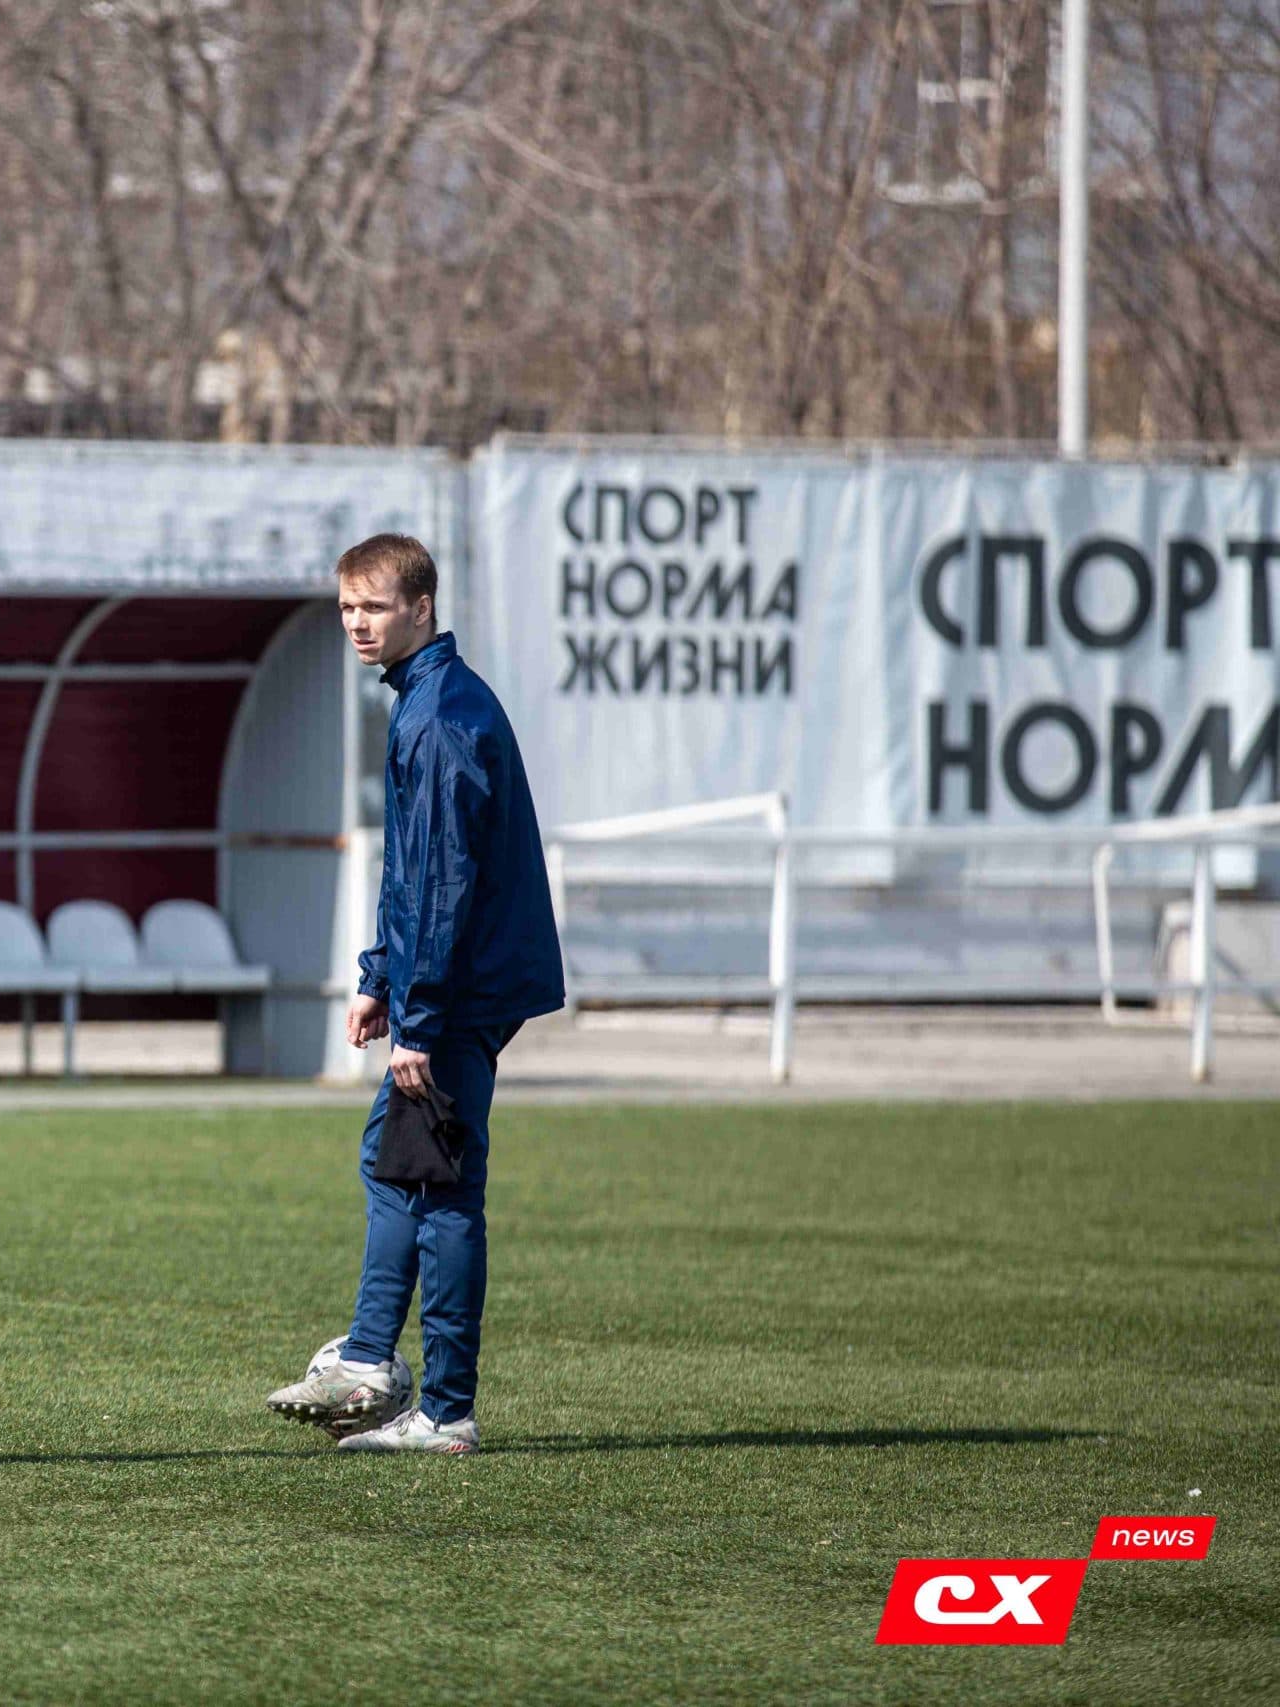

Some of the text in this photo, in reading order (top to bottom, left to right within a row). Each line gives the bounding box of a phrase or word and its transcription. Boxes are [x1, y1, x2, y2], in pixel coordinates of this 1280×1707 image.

[561, 482, 756, 546] СПОРТ
[561, 559, 799, 622] НОРМА
[919, 534, 1280, 650] СПОРТ
[560, 635, 794, 696] ЖИЗНИ
